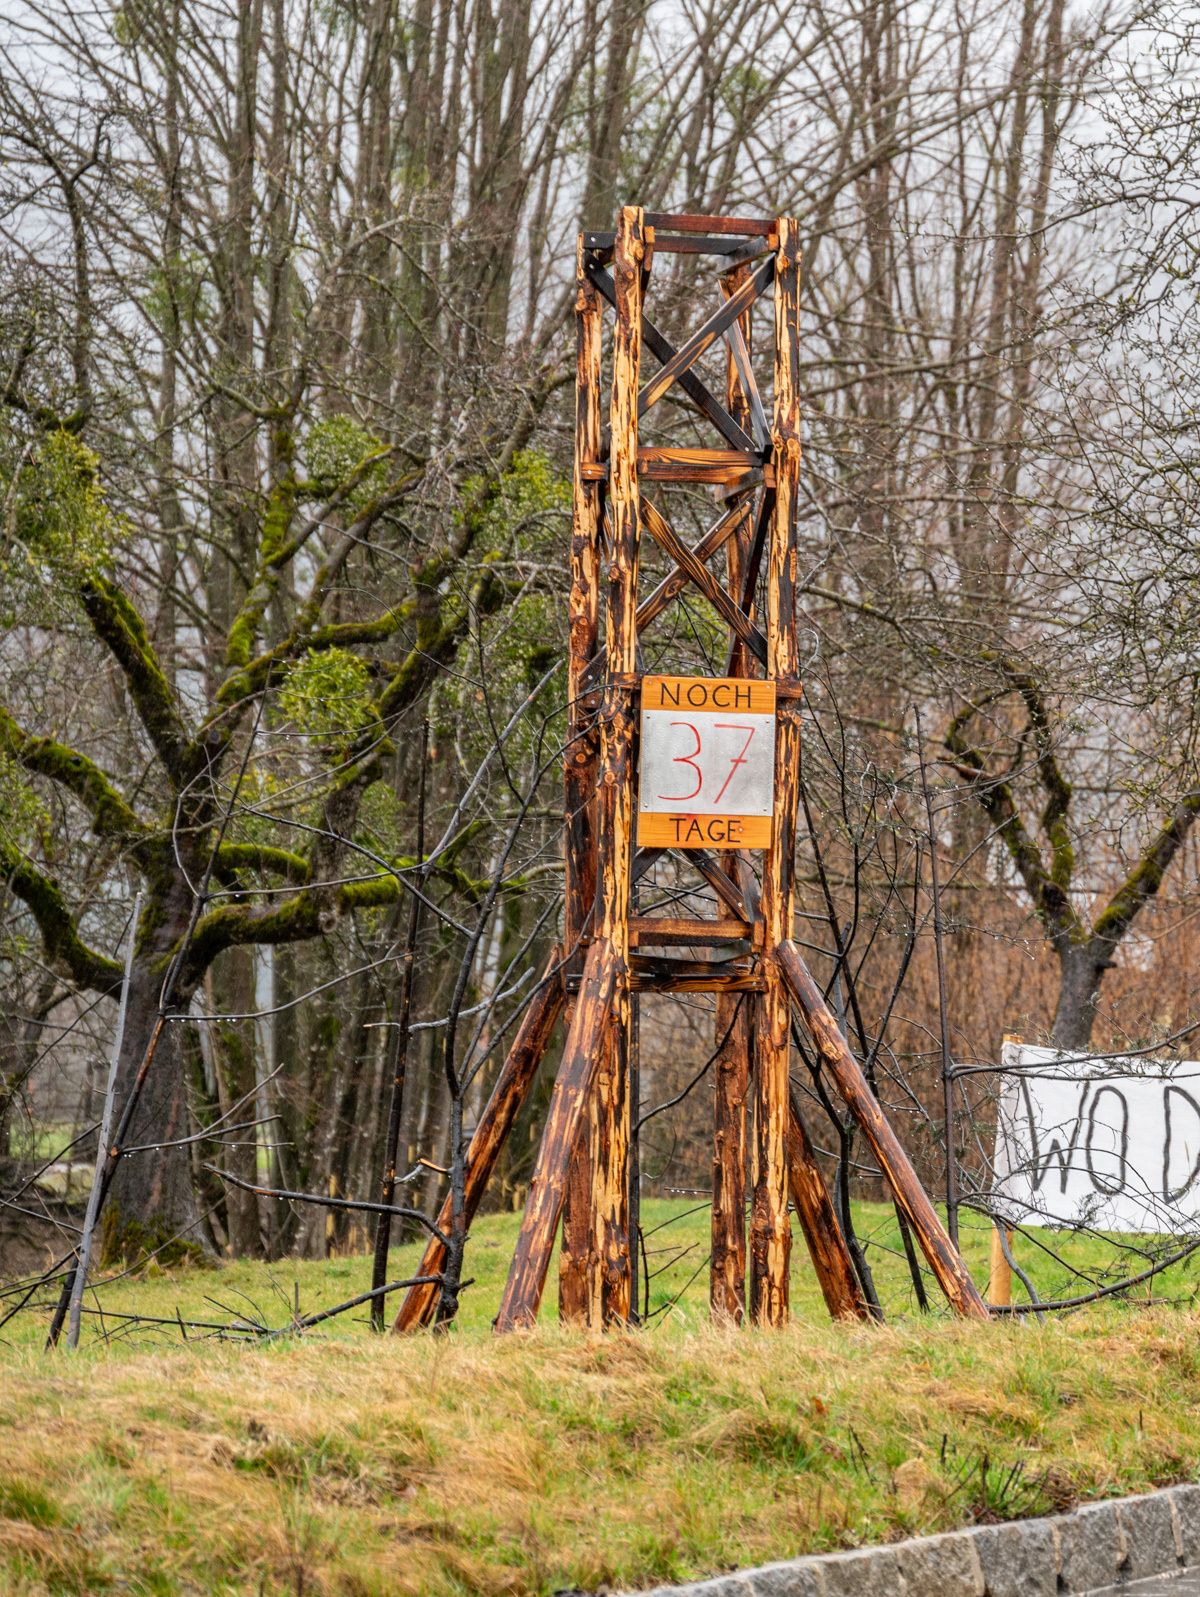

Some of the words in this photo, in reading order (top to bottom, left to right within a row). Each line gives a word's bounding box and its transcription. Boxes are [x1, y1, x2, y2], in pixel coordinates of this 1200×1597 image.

[660, 683, 752, 708] NOCH
[657, 721, 756, 804] 37
[669, 817, 741, 843] TAGE
[1020, 1078, 1129, 1196] WO
